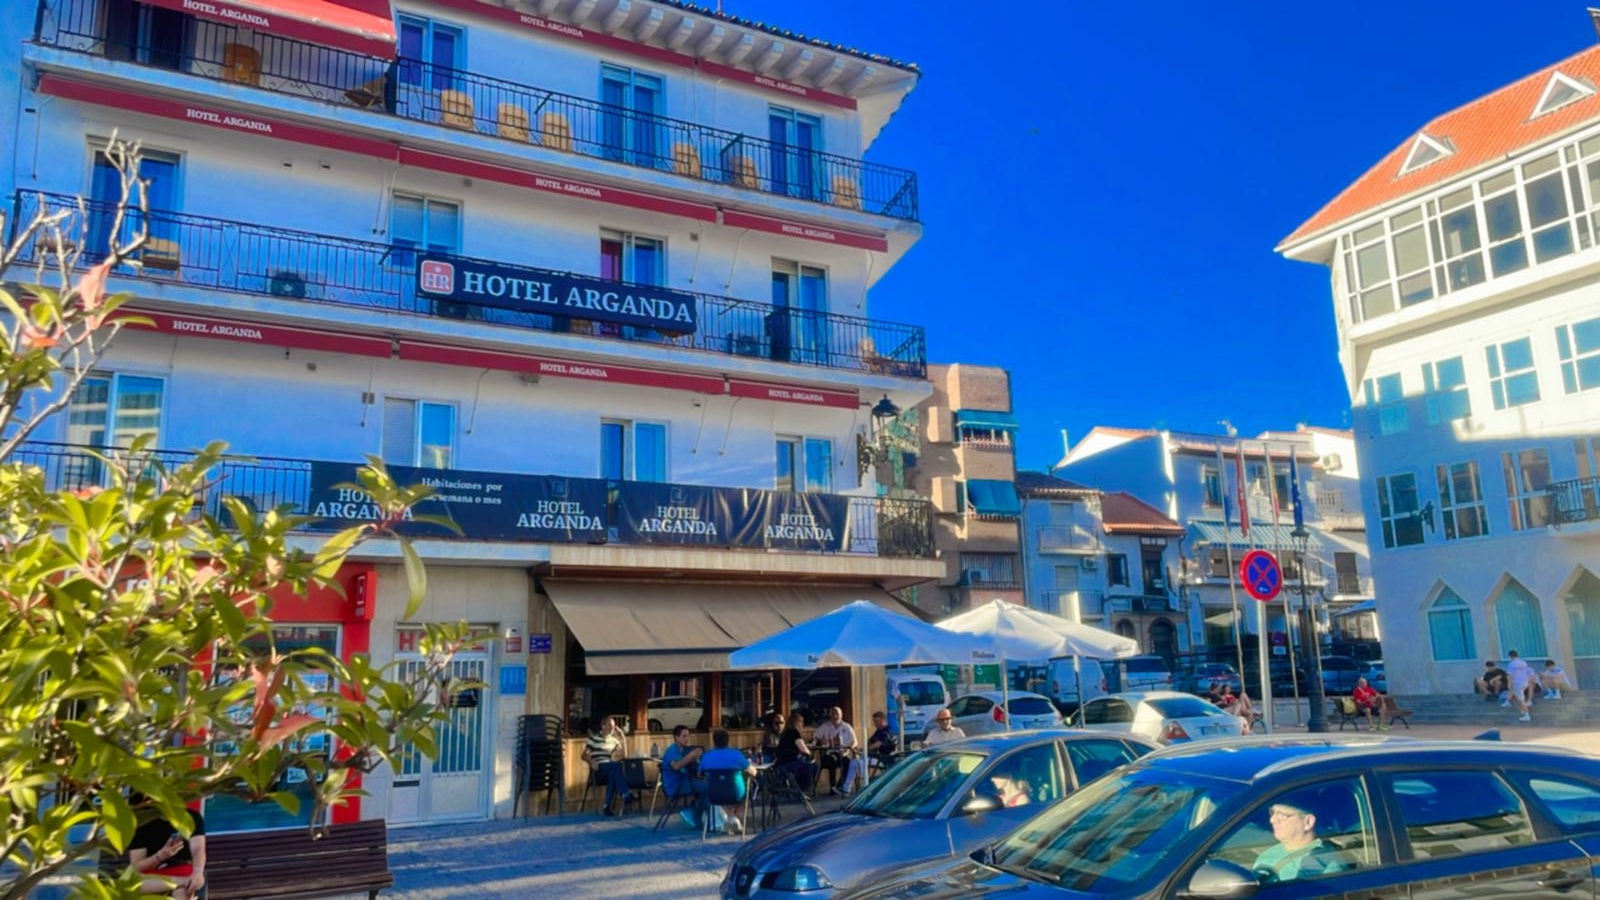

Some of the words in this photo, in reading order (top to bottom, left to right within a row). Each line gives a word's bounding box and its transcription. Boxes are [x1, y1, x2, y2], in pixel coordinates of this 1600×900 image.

[183, 0, 218, 15] HOTEL
[220, 8, 270, 27] ARGANDA
[520, 15, 546, 28] HOTEL
[547, 22, 584, 38] ARGANDA
[186, 109, 221, 123] HOTEL
[223, 116, 272, 133] ARGANDA
[535, 178, 562, 190] HOTEL
[563, 183, 602, 197] ARGANDA
[425, 272, 450, 290] HR
[462, 271, 558, 304] HOTEL
[565, 286, 693, 323] ARGANDA
[172, 320, 209, 333] HOTEL
[211, 325, 262, 339] ARGANDA
[540, 363, 568, 373] HOTEL
[569, 366, 608, 378] ARGANDA
[768, 389, 791, 399] HOTEL
[792, 392, 824, 402] ARGANDA
[422, 477, 482, 490] Habitaciones
[486, 483, 503, 493] por
[474, 496, 481, 504] o
[483, 497, 502, 505] mes
[537, 500, 584, 515] HOTEL
[656, 505, 700, 520] HOTEL
[780, 513, 819, 528] HOTEL
[516, 513, 604, 530] ARGANDA
[639, 518, 718, 536] ARGANDA
[764, 525, 834, 541] ARGANDA
